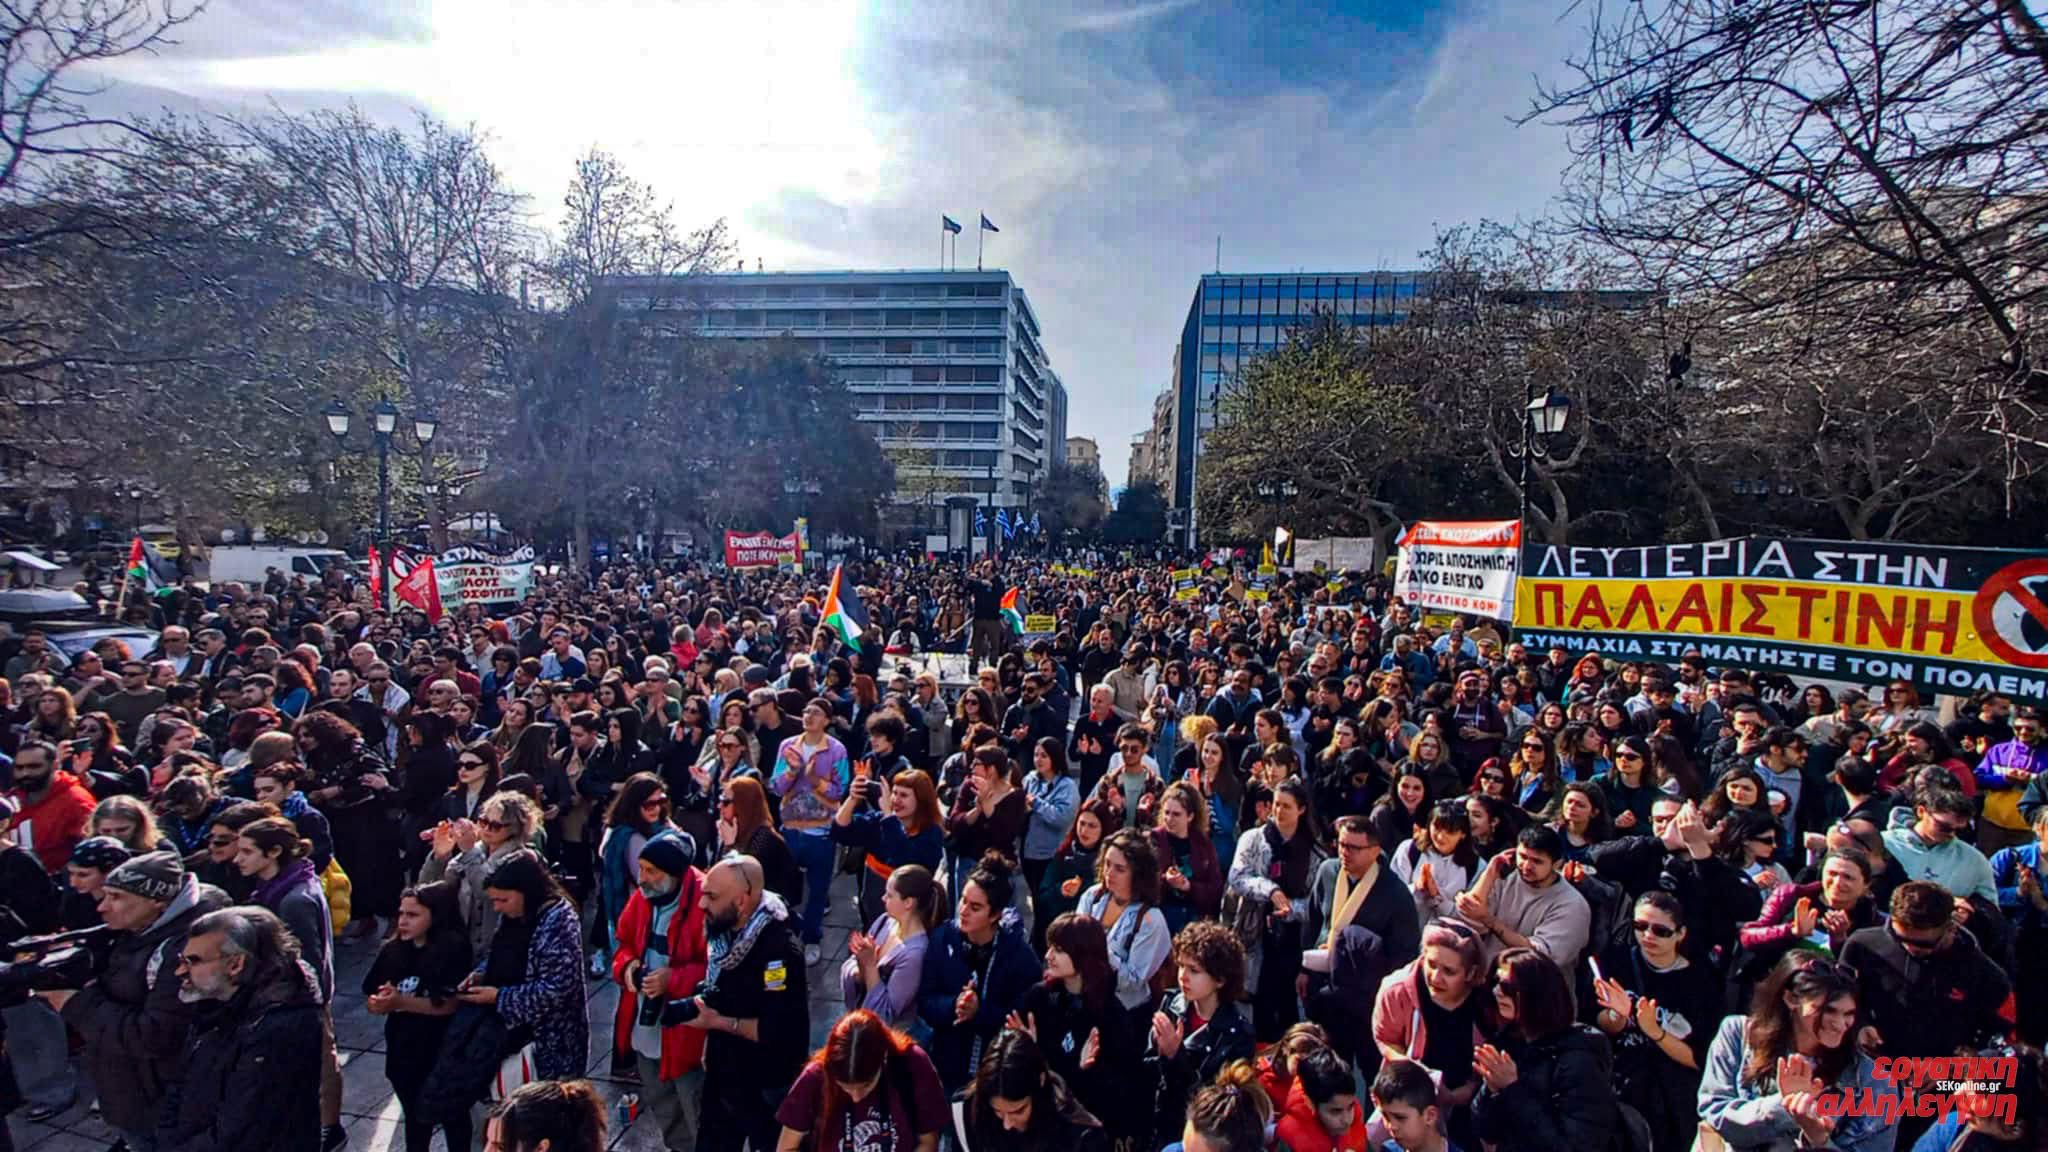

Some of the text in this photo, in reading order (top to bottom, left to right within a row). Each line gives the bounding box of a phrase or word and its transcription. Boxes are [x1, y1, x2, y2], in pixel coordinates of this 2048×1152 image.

[1537, 539, 1948, 588] ΛΕΥΤΕΡΙΑ ΣΤΗΝ
[1534, 581, 1962, 655] ΠΑΛΑΙΣΤΙΝΗ
[1521, 633, 2048, 700] ΣΥΜΜΑΧΙΑ ΣΤΑΜΑΤΗΣΤΕ ΤΟΝ ΠΟΛΕΜ
